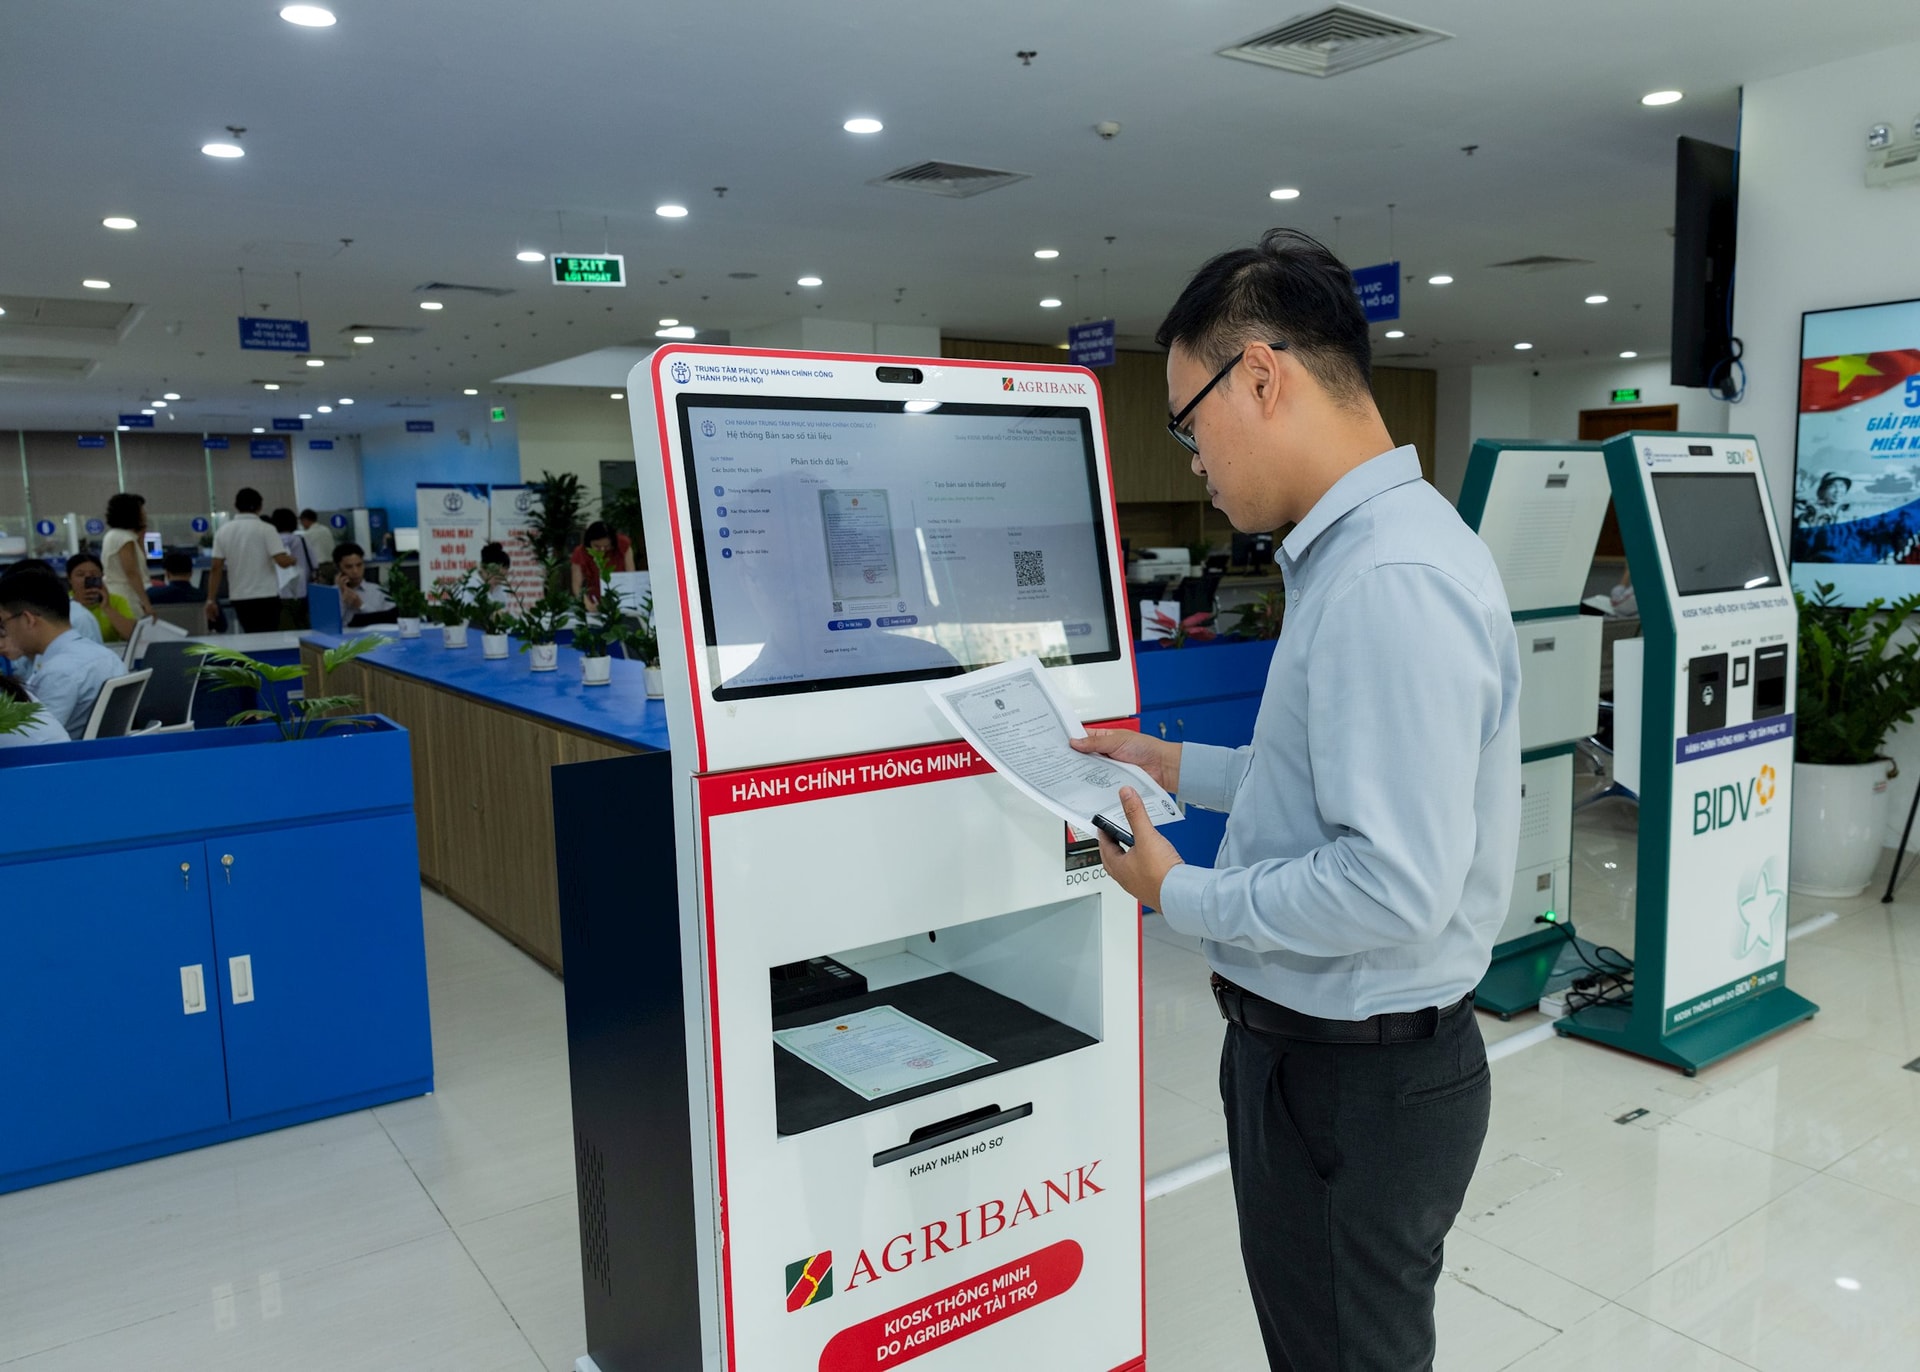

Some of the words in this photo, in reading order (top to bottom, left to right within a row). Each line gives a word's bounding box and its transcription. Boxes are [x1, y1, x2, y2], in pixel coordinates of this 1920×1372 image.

[568, 259, 606, 272] EXIT
[582, 271, 612, 282] THOÁT
[694, 365, 720, 373] TRUNG
[739, 367, 758, 375] PHỤC
[760, 368, 769, 376] VỤ
[771, 368, 790, 376] HÀNH
[791, 369, 812, 377] CHÍNH
[814, 369, 834, 378] CÔNG
[696, 374, 721, 382] THÀNH
[751, 376, 764, 384] NỘI
[1017, 381, 1087, 394] AGRIBANK
[1866, 412, 1899, 432] GIẢI
[1899, 415, 1920, 429] PH
[726, 431, 738, 440] Hệ
[740, 430, 764, 441] thống
[765, 431, 780, 439] Bản
[796, 431, 805, 440] số
[807, 431, 817, 440] tài
[818, 432, 832, 441] liệu
[790, 457, 808, 465] Phân
[809, 457, 824, 465] tích
[825, 457, 835, 465] dữ
[836, 458, 849, 466] liệu
[1725, 451, 1746, 465] BIDV
[197, 518, 203, 530] 7
[432, 528, 456, 539] THANG
[441, 543, 454, 556] NỘI
[456, 544, 466, 555] BỘ
[1682, 609, 1698, 618] KIOSK
[1685, 742, 1701, 755] HÀNH
[1700, 739, 1717, 751] CHÍNH
[1716, 735, 1733, 747] THÔNG
[1732, 732, 1746, 743] MINH
[1767, 724, 1780, 736] PHỤC
[732, 774, 790, 802] HÀNH
[794, 768, 855, 792] CHÍNH
[859, 758, 922, 782] THÔNG
[926, 752, 971, 773] MINH
[1693, 777, 1757, 836] BIDV
[1066, 871, 1090, 885] ĐỌC
[1674, 1008, 1692, 1023] KIOSK
[1692, 999, 1712, 1014] THÔNG
[1735, 979, 1751, 996] BIDV
[910, 1159, 938, 1177] KHAY
[940, 1149, 969, 1166] NHẬN
[972, 1141, 986, 1155] HỒ
[989, 1136, 1004, 1149] SƠ
[844, 1159, 1106, 1292] AGRIBANK
[884, 1305, 933, 1337] KIOSK
[934, 1283, 989, 1315] THÔNG
[992, 1264, 1030, 1293] MINH
[877, 1340, 901, 1362] DO
[903, 1305, 982, 1351] AGRIBANK
[984, 1294, 1006, 1315] TÀI
[1008, 1280, 1038, 1304] TRỢ
